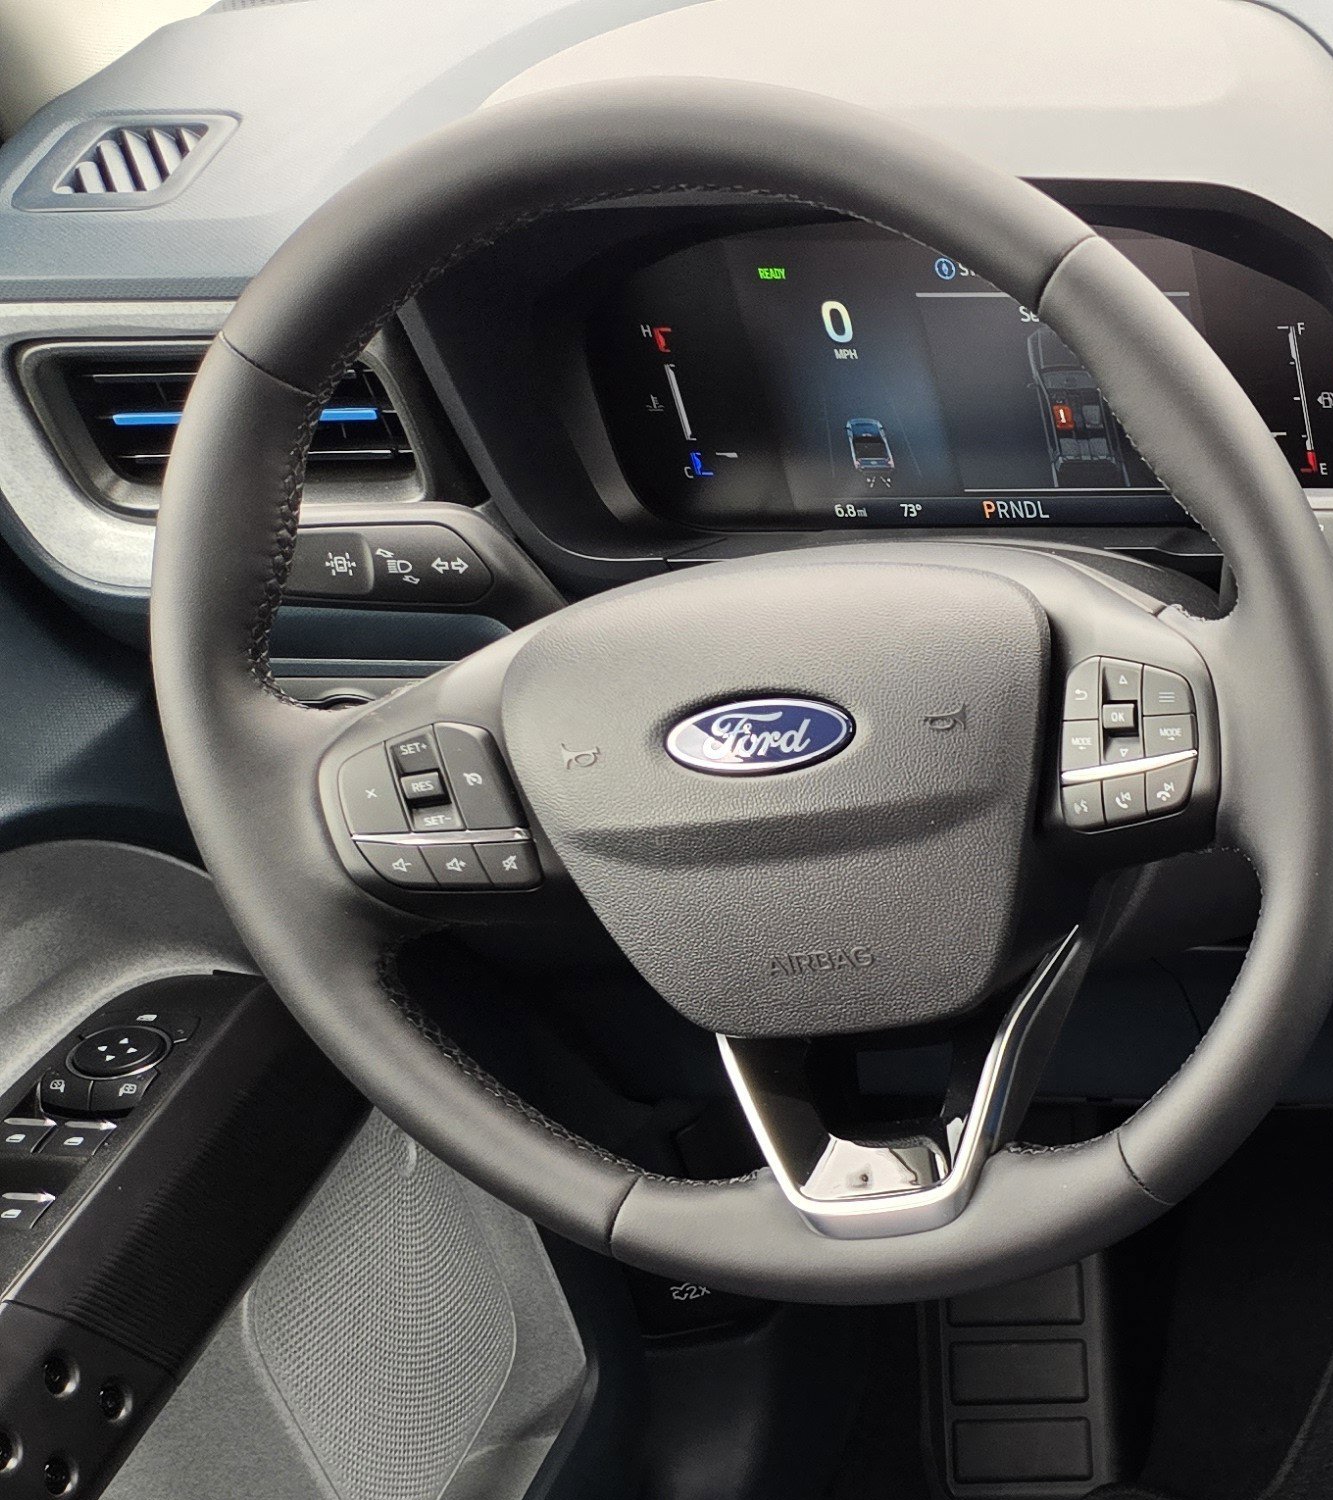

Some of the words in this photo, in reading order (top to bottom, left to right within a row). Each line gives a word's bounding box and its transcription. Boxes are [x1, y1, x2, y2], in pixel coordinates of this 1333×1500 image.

[758, 267, 786, 280] READY
[821, 300, 853, 343] 0
[640, 324, 652, 338] H
[1297, 322, 1306, 335] F
[834, 349, 858, 360] MPH
[684, 466, 694, 479] C
[1319, 463, 1328, 475] E
[1111, 712, 1125, 722] OK
[702, 711, 811, 762] Ford
[1159, 728, 1182, 737] MODE
[1072, 737, 1093, 746] MODE
[411, 780, 434, 793] RES
[769, 947, 875, 976] AIRBAG
